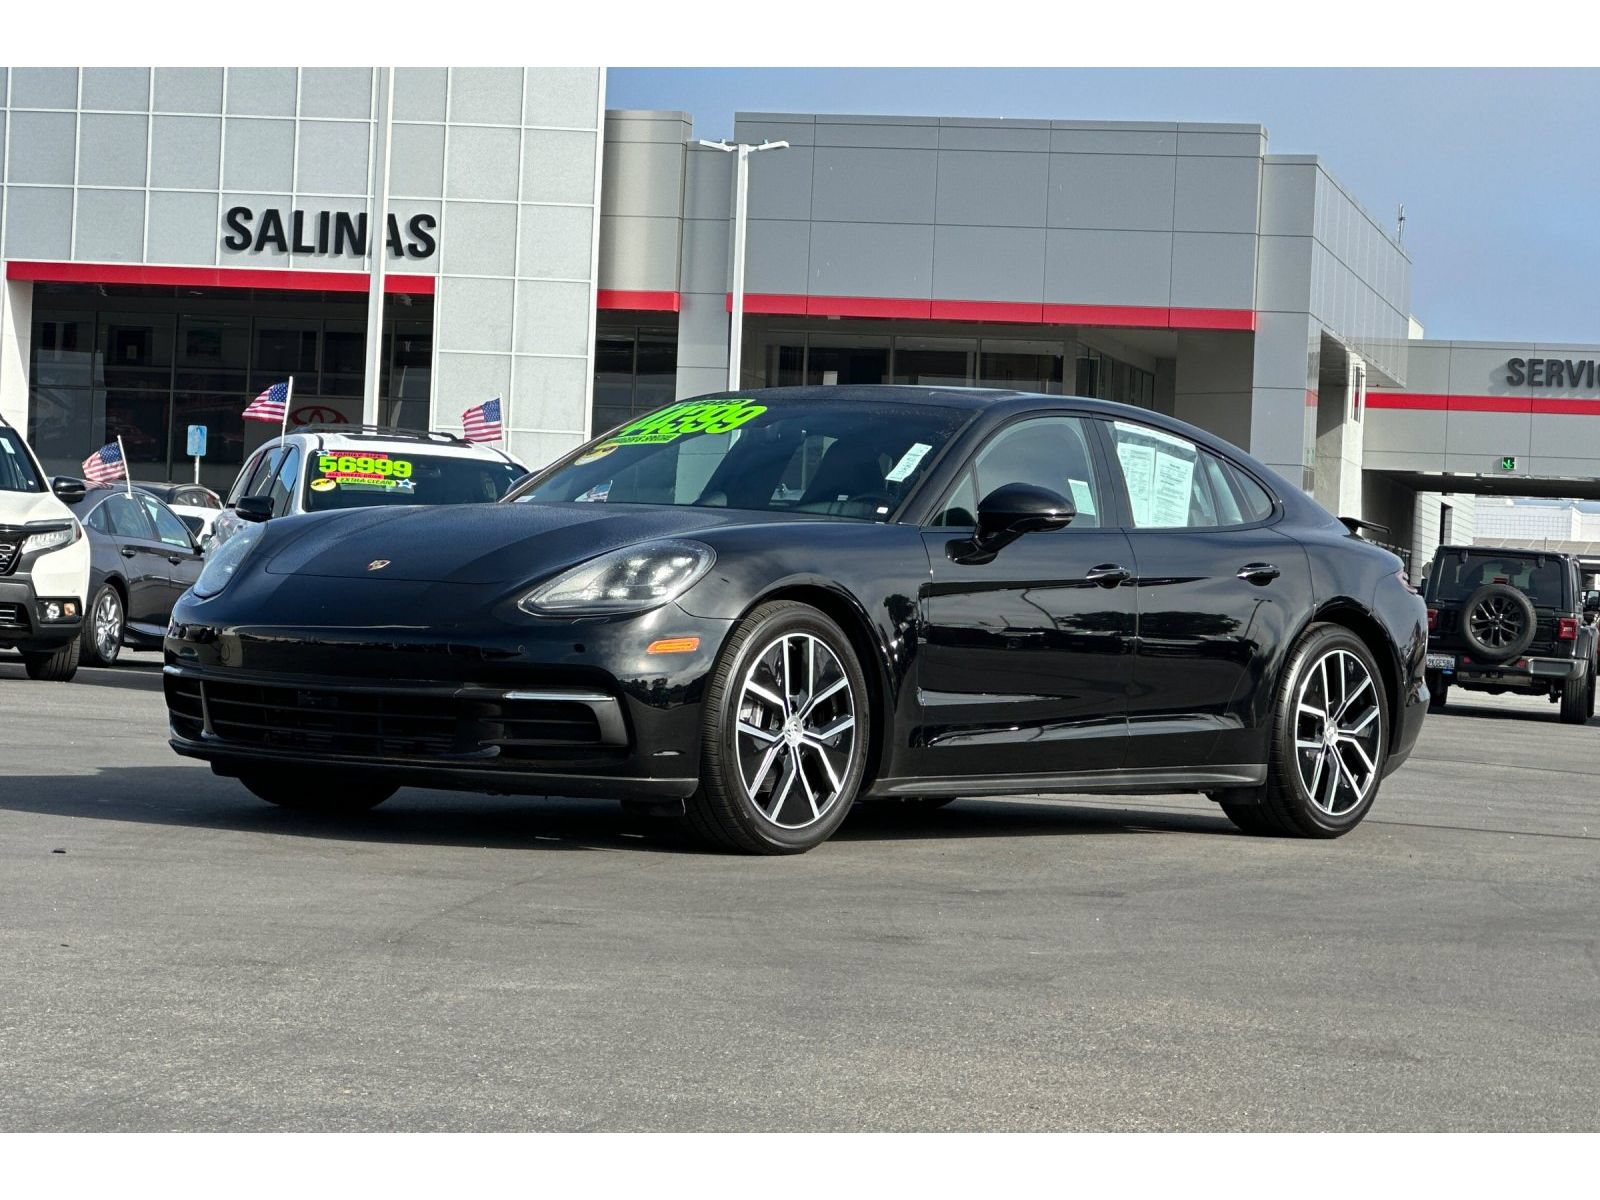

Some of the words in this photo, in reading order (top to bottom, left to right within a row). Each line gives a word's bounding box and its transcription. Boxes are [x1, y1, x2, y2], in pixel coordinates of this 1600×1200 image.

[224, 206, 437, 258] SALINAS
[1506, 357, 1600, 389] SERVI
[318, 456, 412, 478] 56999
